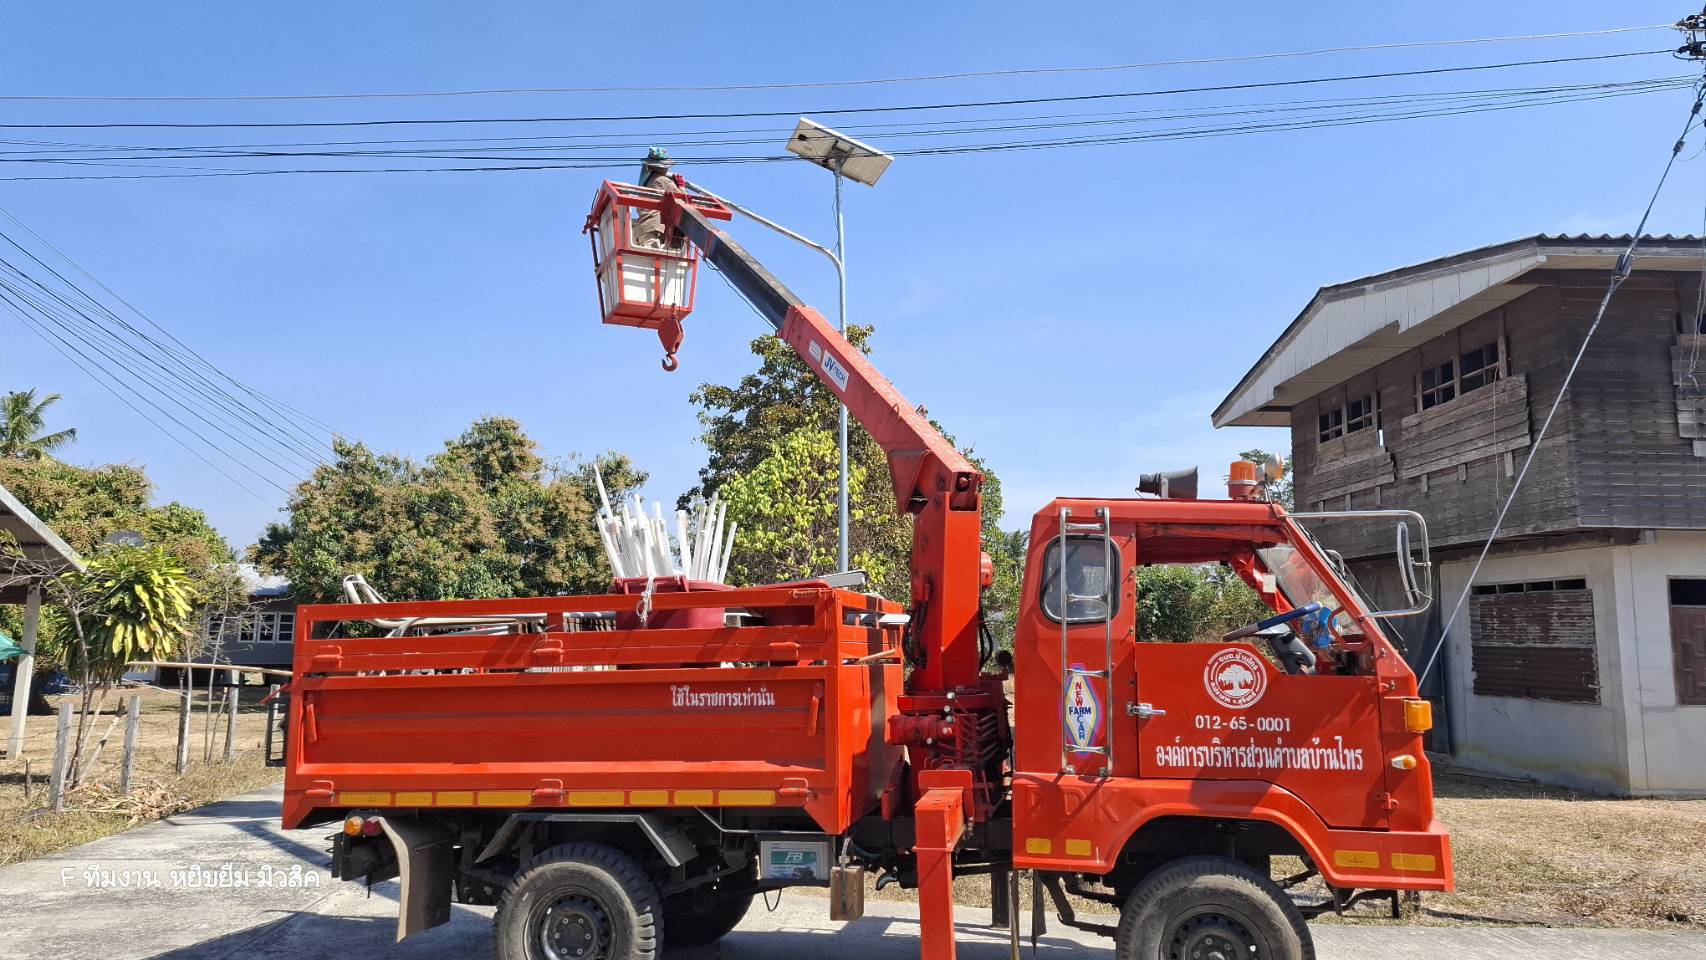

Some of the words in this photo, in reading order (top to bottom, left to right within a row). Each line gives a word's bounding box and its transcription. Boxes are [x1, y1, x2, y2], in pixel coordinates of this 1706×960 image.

[1075, 681, 1084, 707] NEW
[1069, 706, 1092, 716] FARM
[1195, 714, 1291, 732] 012-65-0001
[1077, 715, 1086, 740] CAR
[1156, 735, 1364, 771] องค์การบริหารส่วนตำบลบ้านไทร
